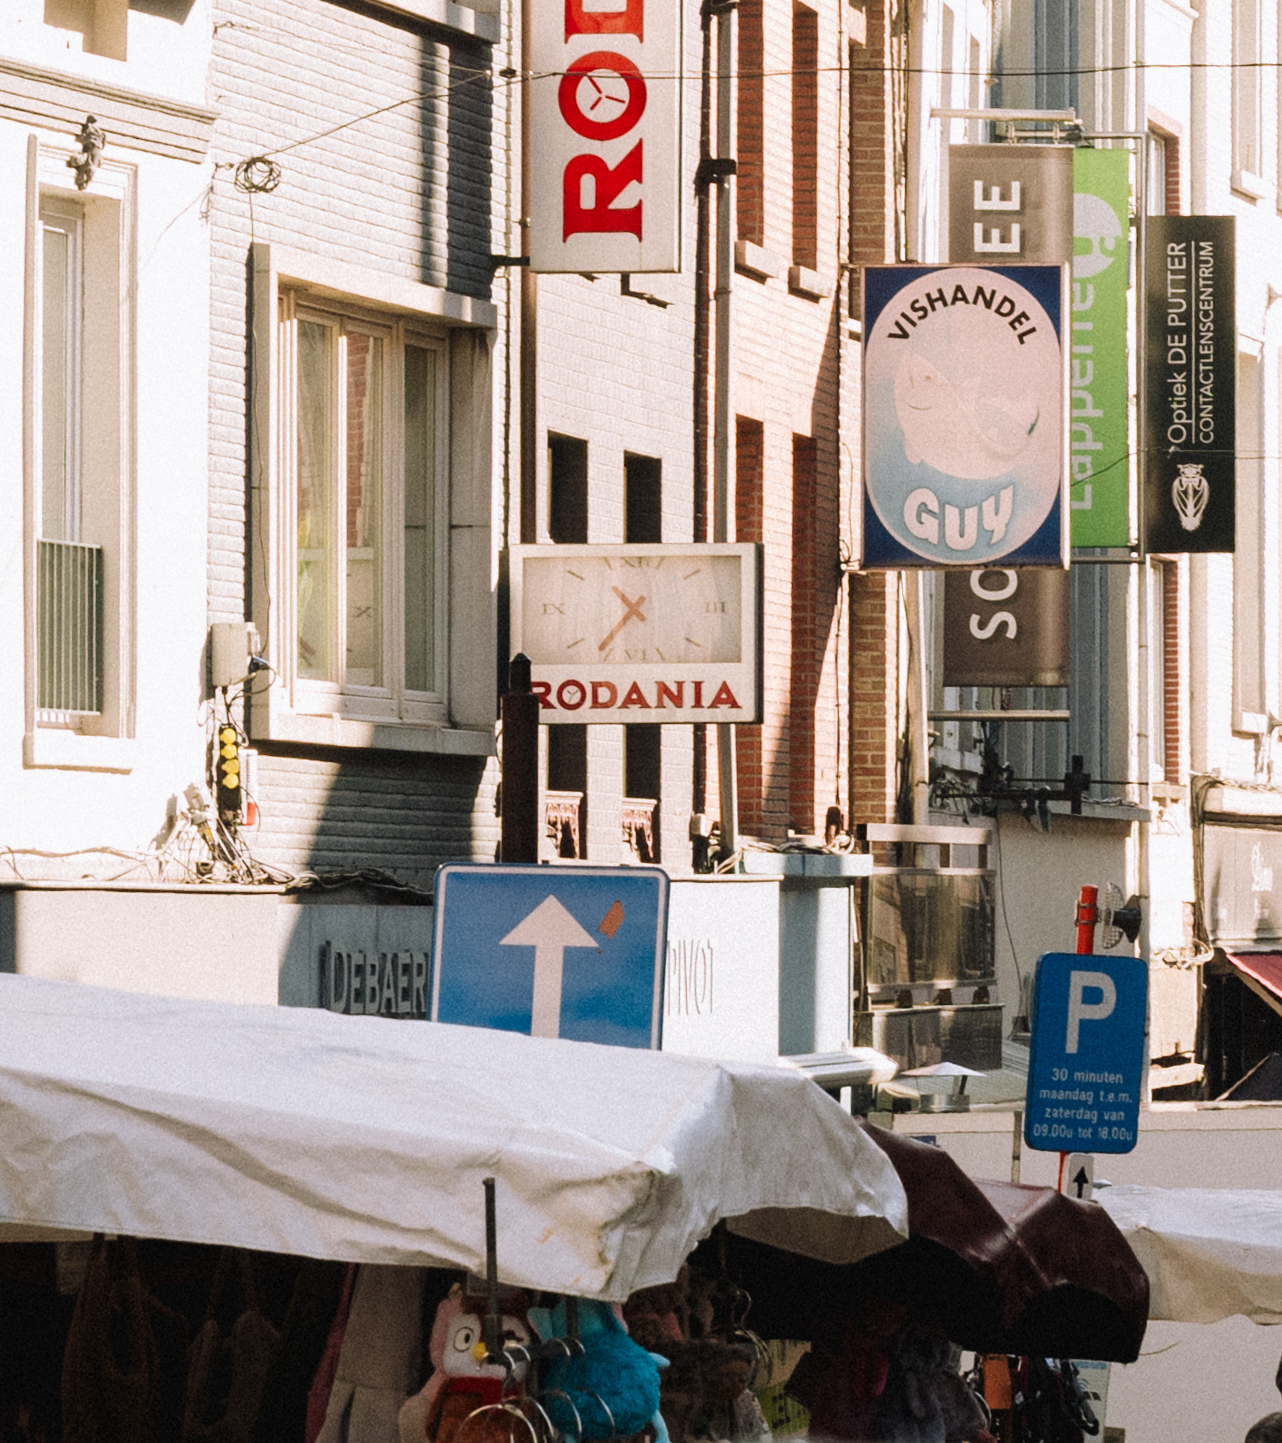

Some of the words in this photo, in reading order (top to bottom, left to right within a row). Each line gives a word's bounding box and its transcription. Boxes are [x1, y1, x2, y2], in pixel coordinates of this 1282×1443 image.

[1167, 241, 1187, 331] PUTTER
[887, 283, 1039, 346] VISHANDEL
[1167, 334, 1187, 365] DE
[1199, 241, 1214, 444] CONTACTLENSCENTRUM
[1167, 372, 1191, 444] Optiek
[902, 484, 1014, 552] GUY
[531, 679, 743, 711] RODANIA
[1065, 970, 1117, 1054] P
[1039, 1088, 1094, 1105] maandag
[1051, 1067, 1069, 1081] 30
[1073, 1070, 1124, 1084] minuten
[1033, 1124, 1073, 1139] 09.00u
[1078, 1126, 1093, 1138] tot
[1097, 1127, 1133, 1141] 18.00u
[1044, 1106, 1098, 1124] zaterdag
[1103, 1110, 1125, 1121] van
